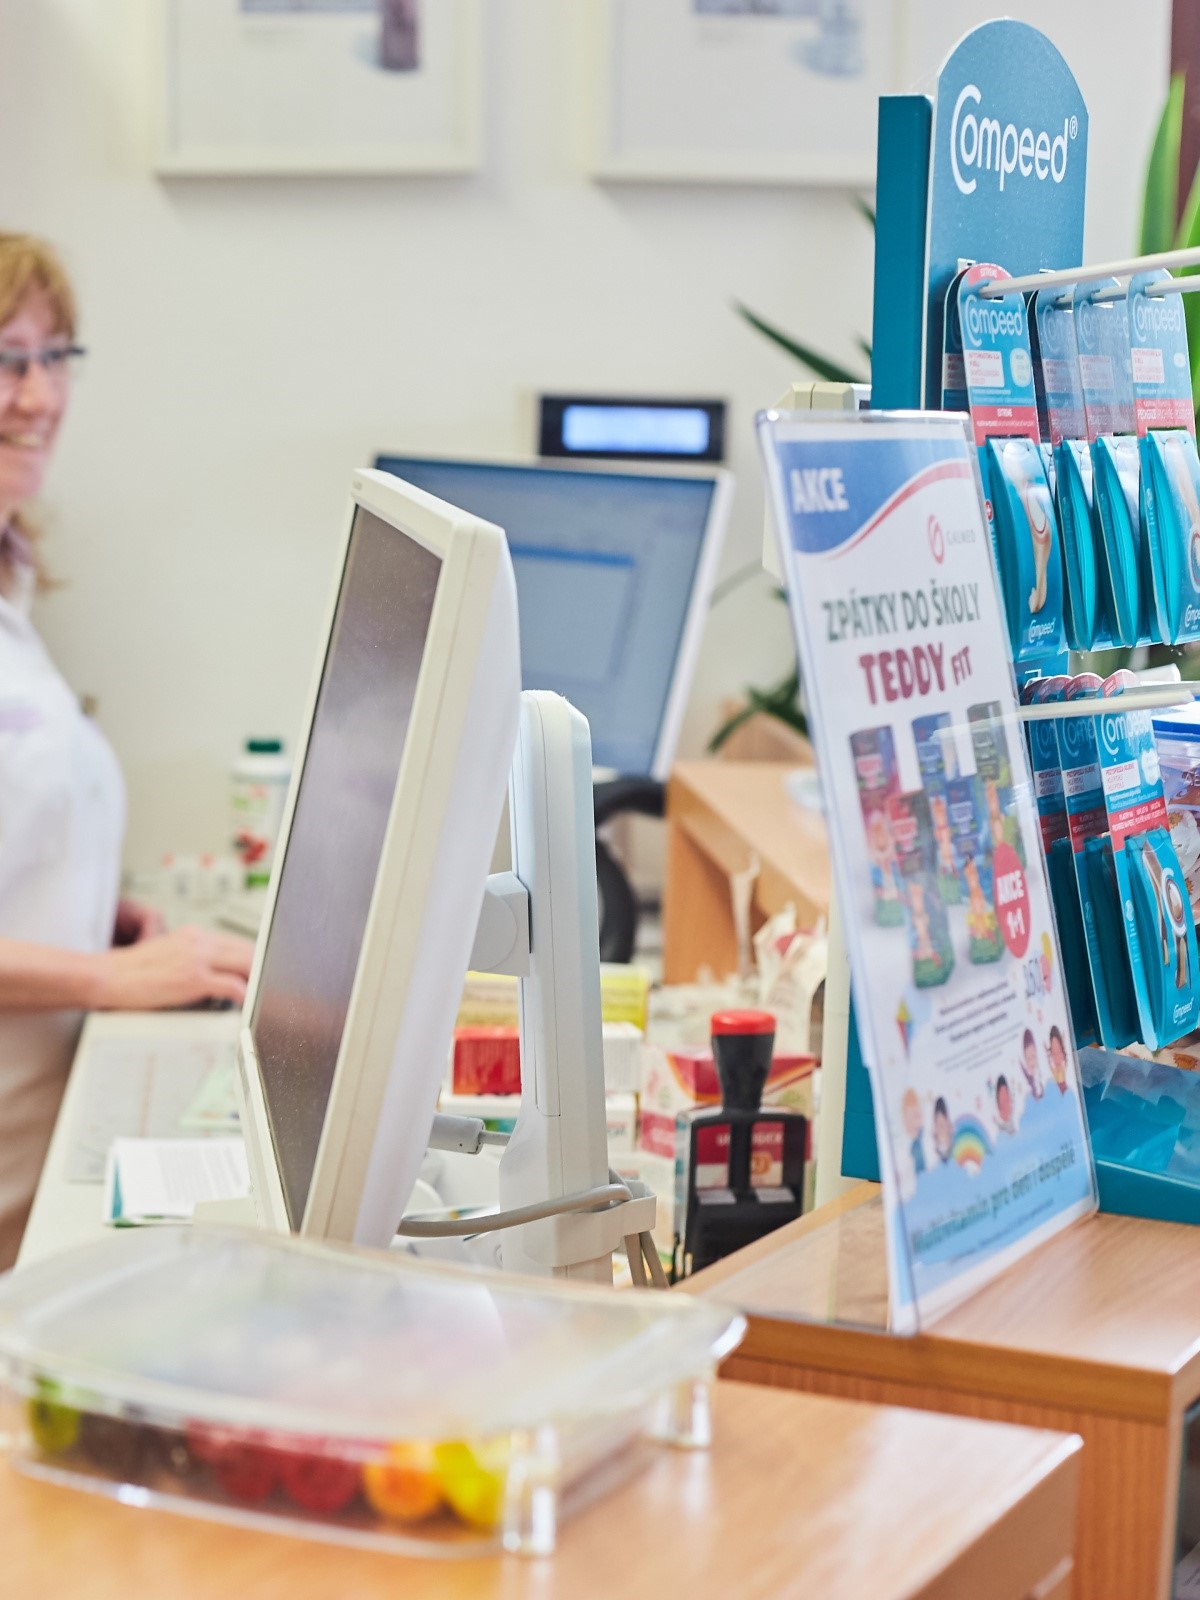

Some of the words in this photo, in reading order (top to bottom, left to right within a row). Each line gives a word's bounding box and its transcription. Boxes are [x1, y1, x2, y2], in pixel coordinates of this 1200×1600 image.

[965, 294, 1023, 347] Compeed
[1133, 293, 1181, 342] Compeed
[790, 468, 849, 513] AKCE
[822, 588, 898, 642] ZPÁTKY
[901, 588, 929, 630] DO
[931, 579, 981, 626] ŠKOLY
[1028, 617, 1056, 643] Compeed
[860, 642, 946, 705] TEDDY
[952, 646, 973, 686] FIT
[996, 870, 1025, 906] AKCE
[1006, 907, 1026, 939] 1+1
[1172, 997, 1195, 1024] Compeed
